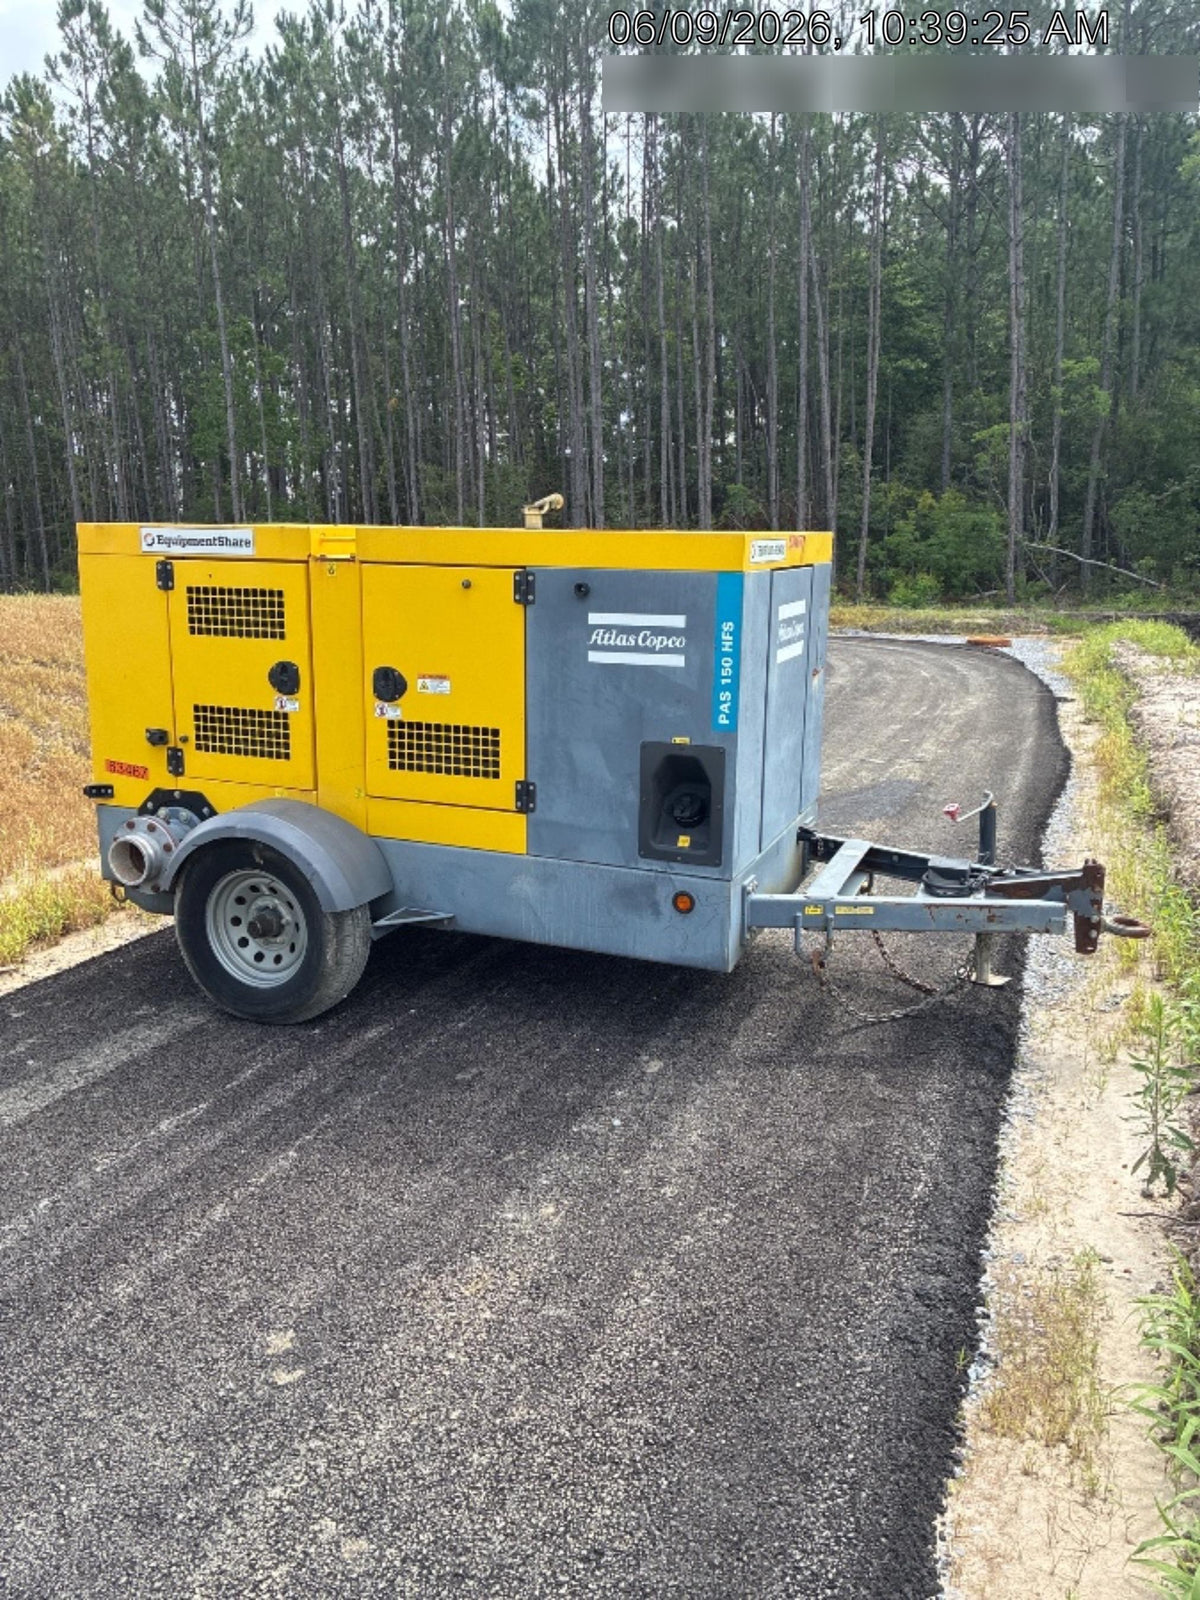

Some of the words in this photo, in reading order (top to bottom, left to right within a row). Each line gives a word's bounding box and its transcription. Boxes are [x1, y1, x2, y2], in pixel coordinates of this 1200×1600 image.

[155, 534, 252, 549] EquipmentShare
[721, 621, 735, 652] HFS
[721, 657, 734, 685] 150
[717, 691, 732, 725] PAS
